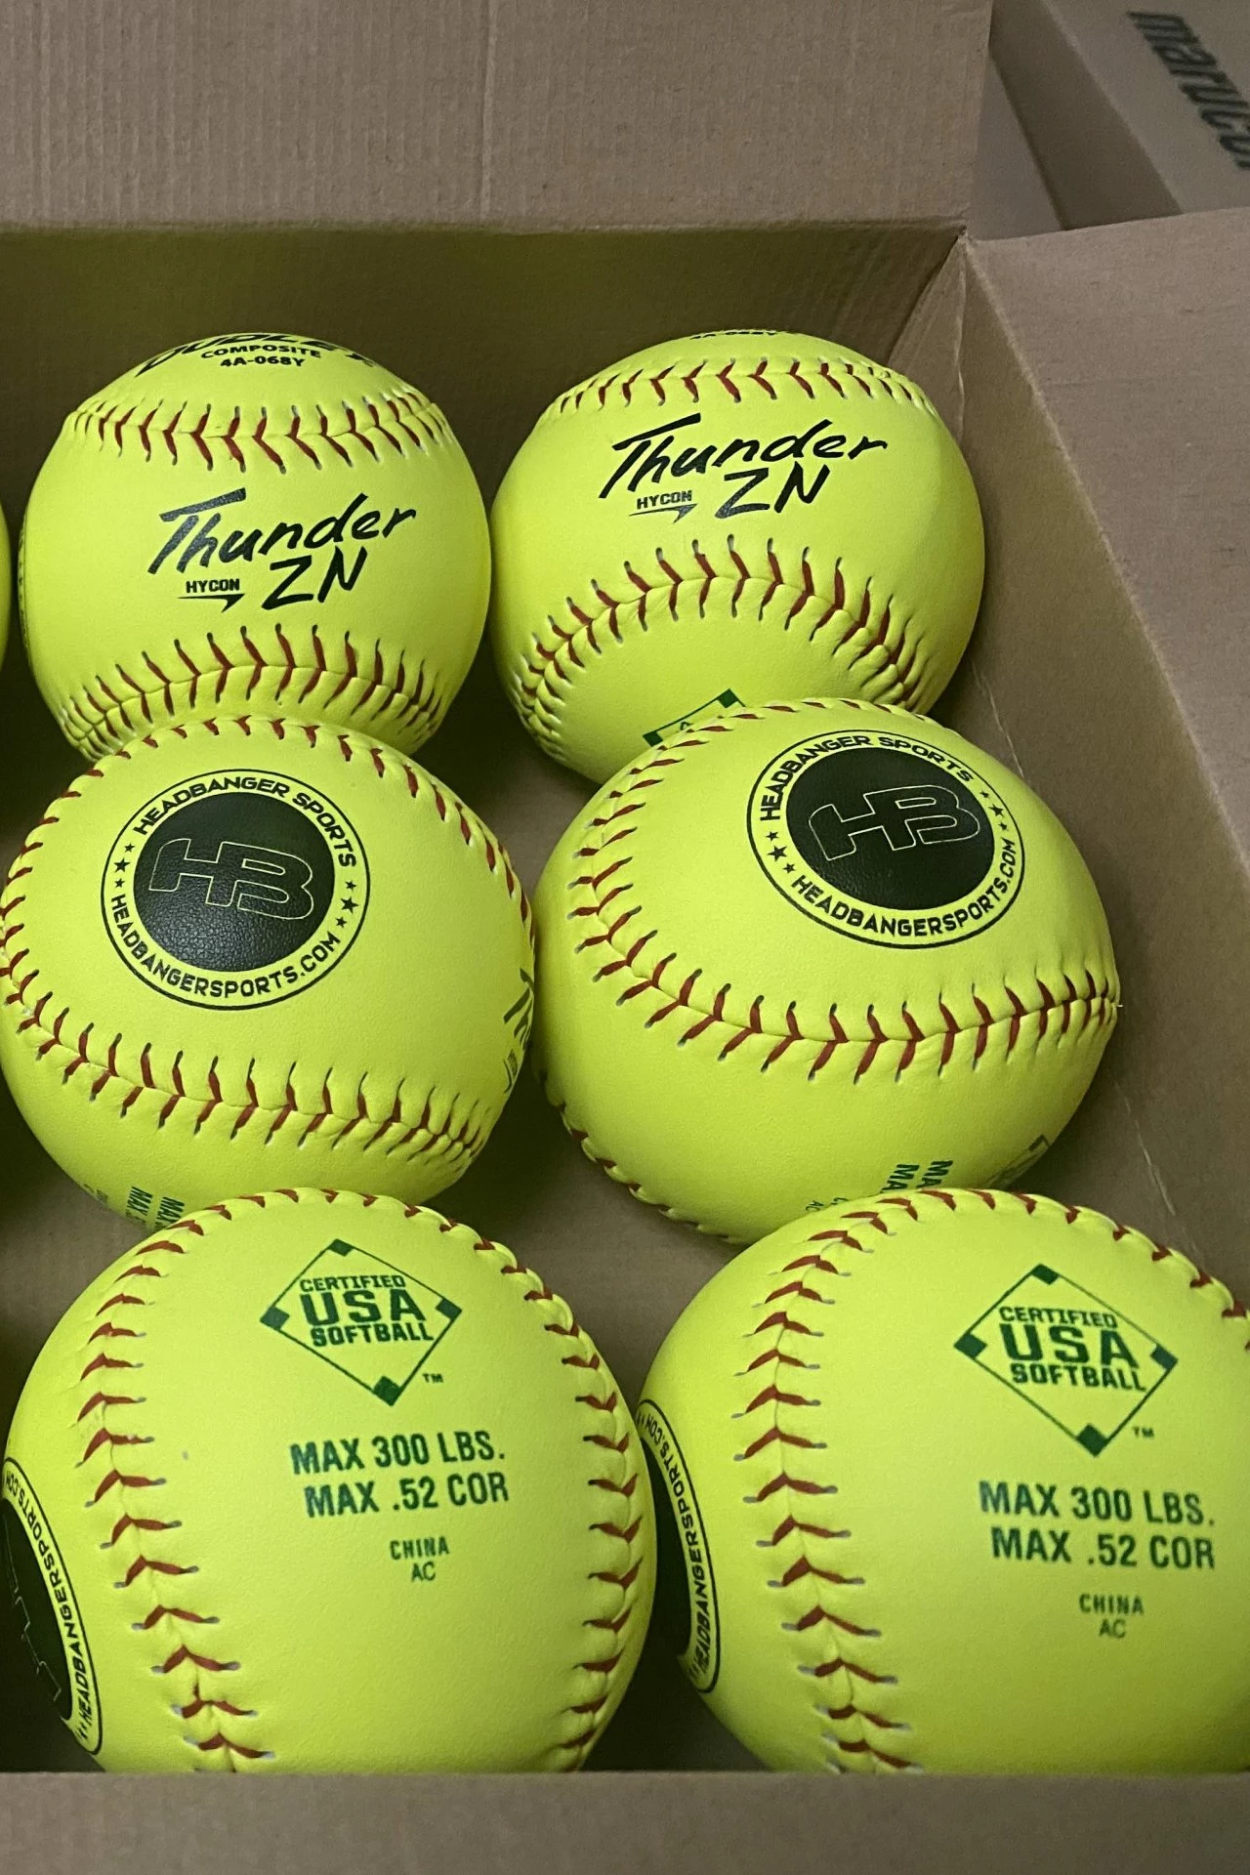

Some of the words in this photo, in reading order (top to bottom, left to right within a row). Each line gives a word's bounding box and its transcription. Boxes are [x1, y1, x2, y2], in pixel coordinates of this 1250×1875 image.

[1126, 11, 1250, 170] maruc
[201, 344, 321, 359] COMPOSITE
[220, 355, 306, 368] 4A-068Y
[599, 413, 887, 499] Thunder
[636, 490, 692, 509] HYCON
[715, 462, 830, 519] ZN
[147, 487, 417, 575] Thunder
[186, 578, 240, 593] HYCON
[261, 546, 368, 610] ZN
[760, 735, 871, 822] HEADBANGER
[877, 736, 974, 783] SPORTS
[133, 776, 290, 836] HEADBANGER
[292, 792, 357, 868] SPORTS
[791, 837, 1016, 937] HEADBANGERSPORTS.COM
[111, 894, 341, 998] HEADBANGERSPORTS.COM
[881, 1163, 920, 1193] MA
[916, 1160, 953, 1189] MA
[300, 1274, 406, 1293] CERTIFIED
[300, 1288, 427, 1327] USA
[999, 1306, 1118, 1329] CERTIFIED
[310, 1322, 435, 1348] SOFTBALL
[999, 1323, 1140, 1370] USA
[1010, 1363, 1147, 1392] SOFTBALL
[289, 1437, 365, 1476] MAX
[371, 1433, 430, 1468] 300
[437, 1430, 505, 1464] LBS.
[304, 1480, 379, 1519] MAX
[392, 1476, 439, 1511] .52
[447, 1471, 509, 1507] COR
[979, 1480, 1059, 1518] MAX
[1070, 1486, 1132, 1522] 300
[1143, 1490, 1215, 1527] LBS.
[389, 1536, 450, 1560] CHINA
[991, 1526, 1072, 1564] MAX
[1088, 1534, 1138, 1568] .52
[1150, 1536, 1216, 1570] COR
[411, 1561, 436, 1582] AC
[1079, 1593, 1144, 1616] CHINA
[1099, 1619, 1127, 1639] AC
